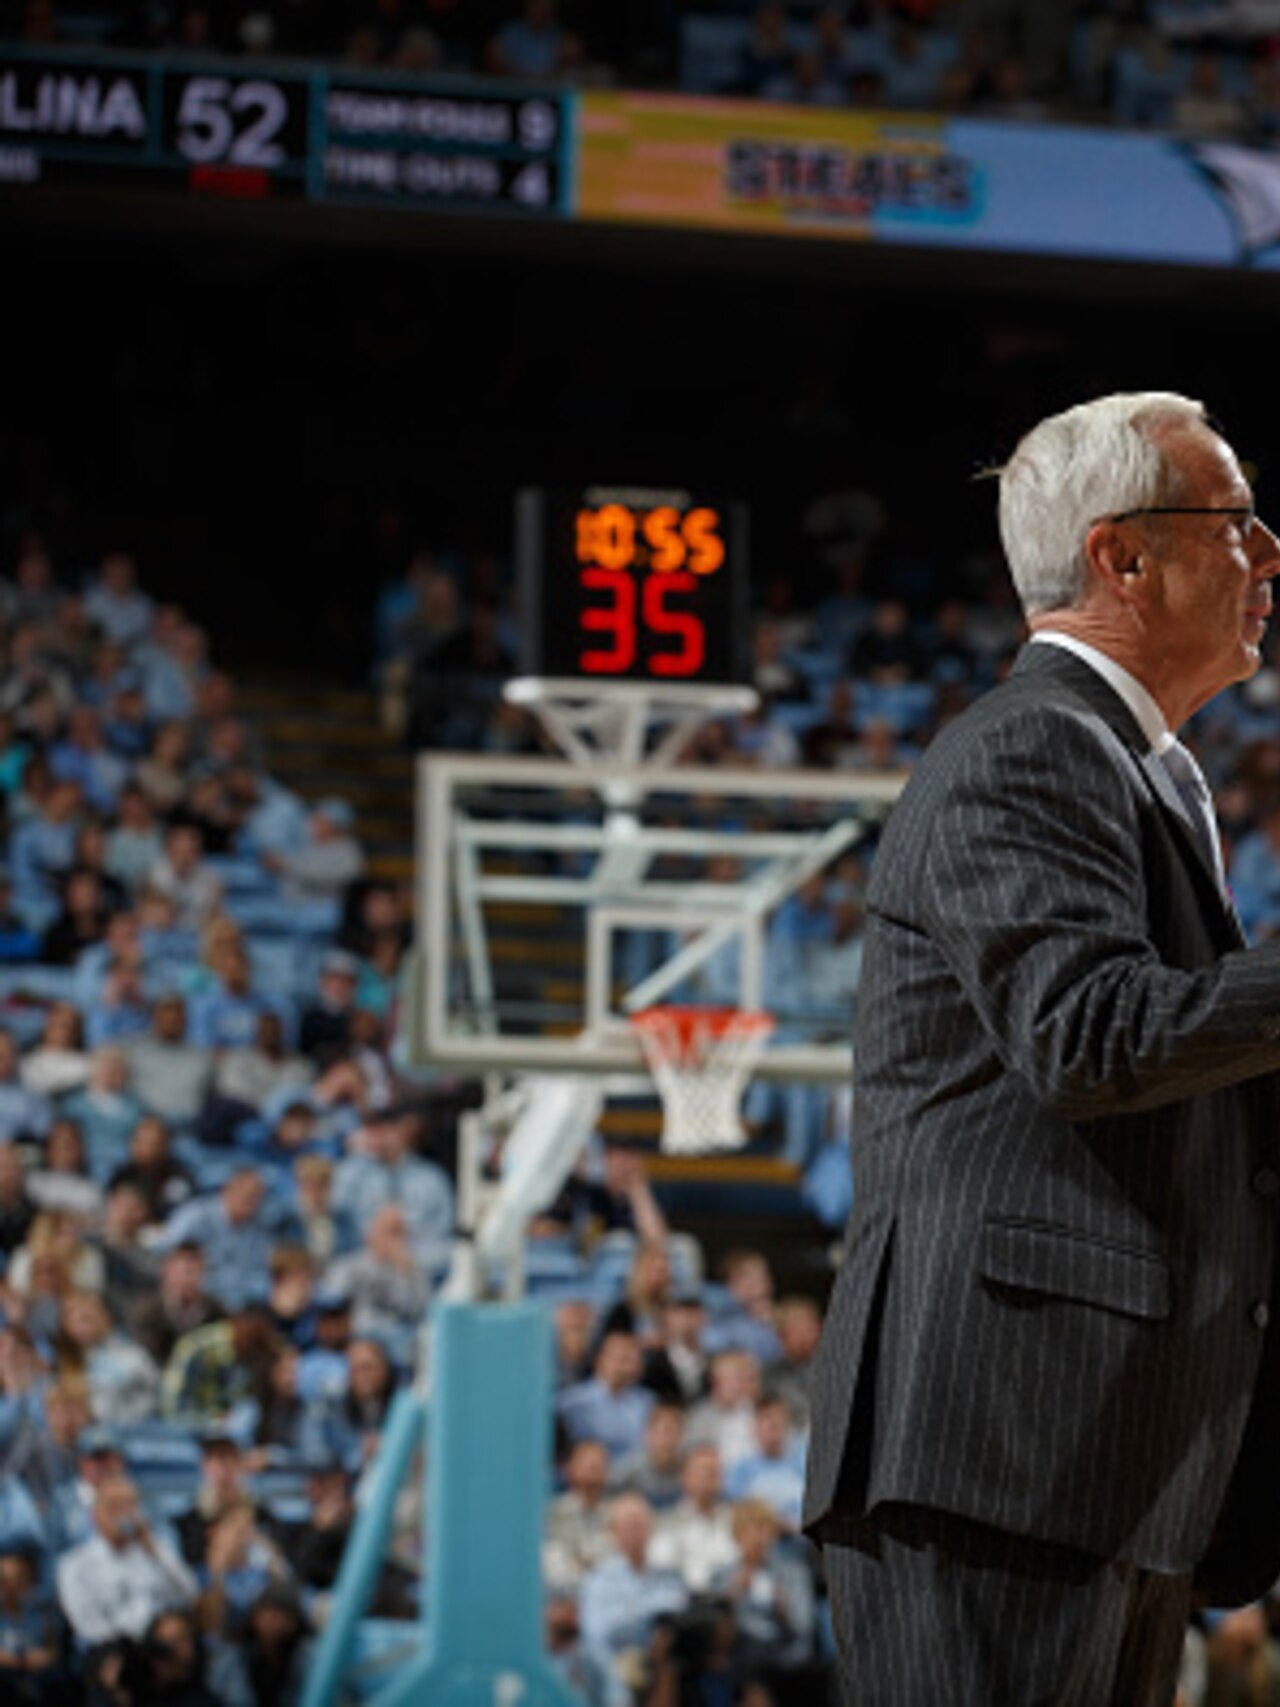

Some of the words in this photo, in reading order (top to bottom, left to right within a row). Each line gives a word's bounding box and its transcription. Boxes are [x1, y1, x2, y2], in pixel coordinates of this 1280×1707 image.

[176, 76, 289, 168] 52
[510, 163, 550, 206] 4
[579, 567, 705, 677] 35
